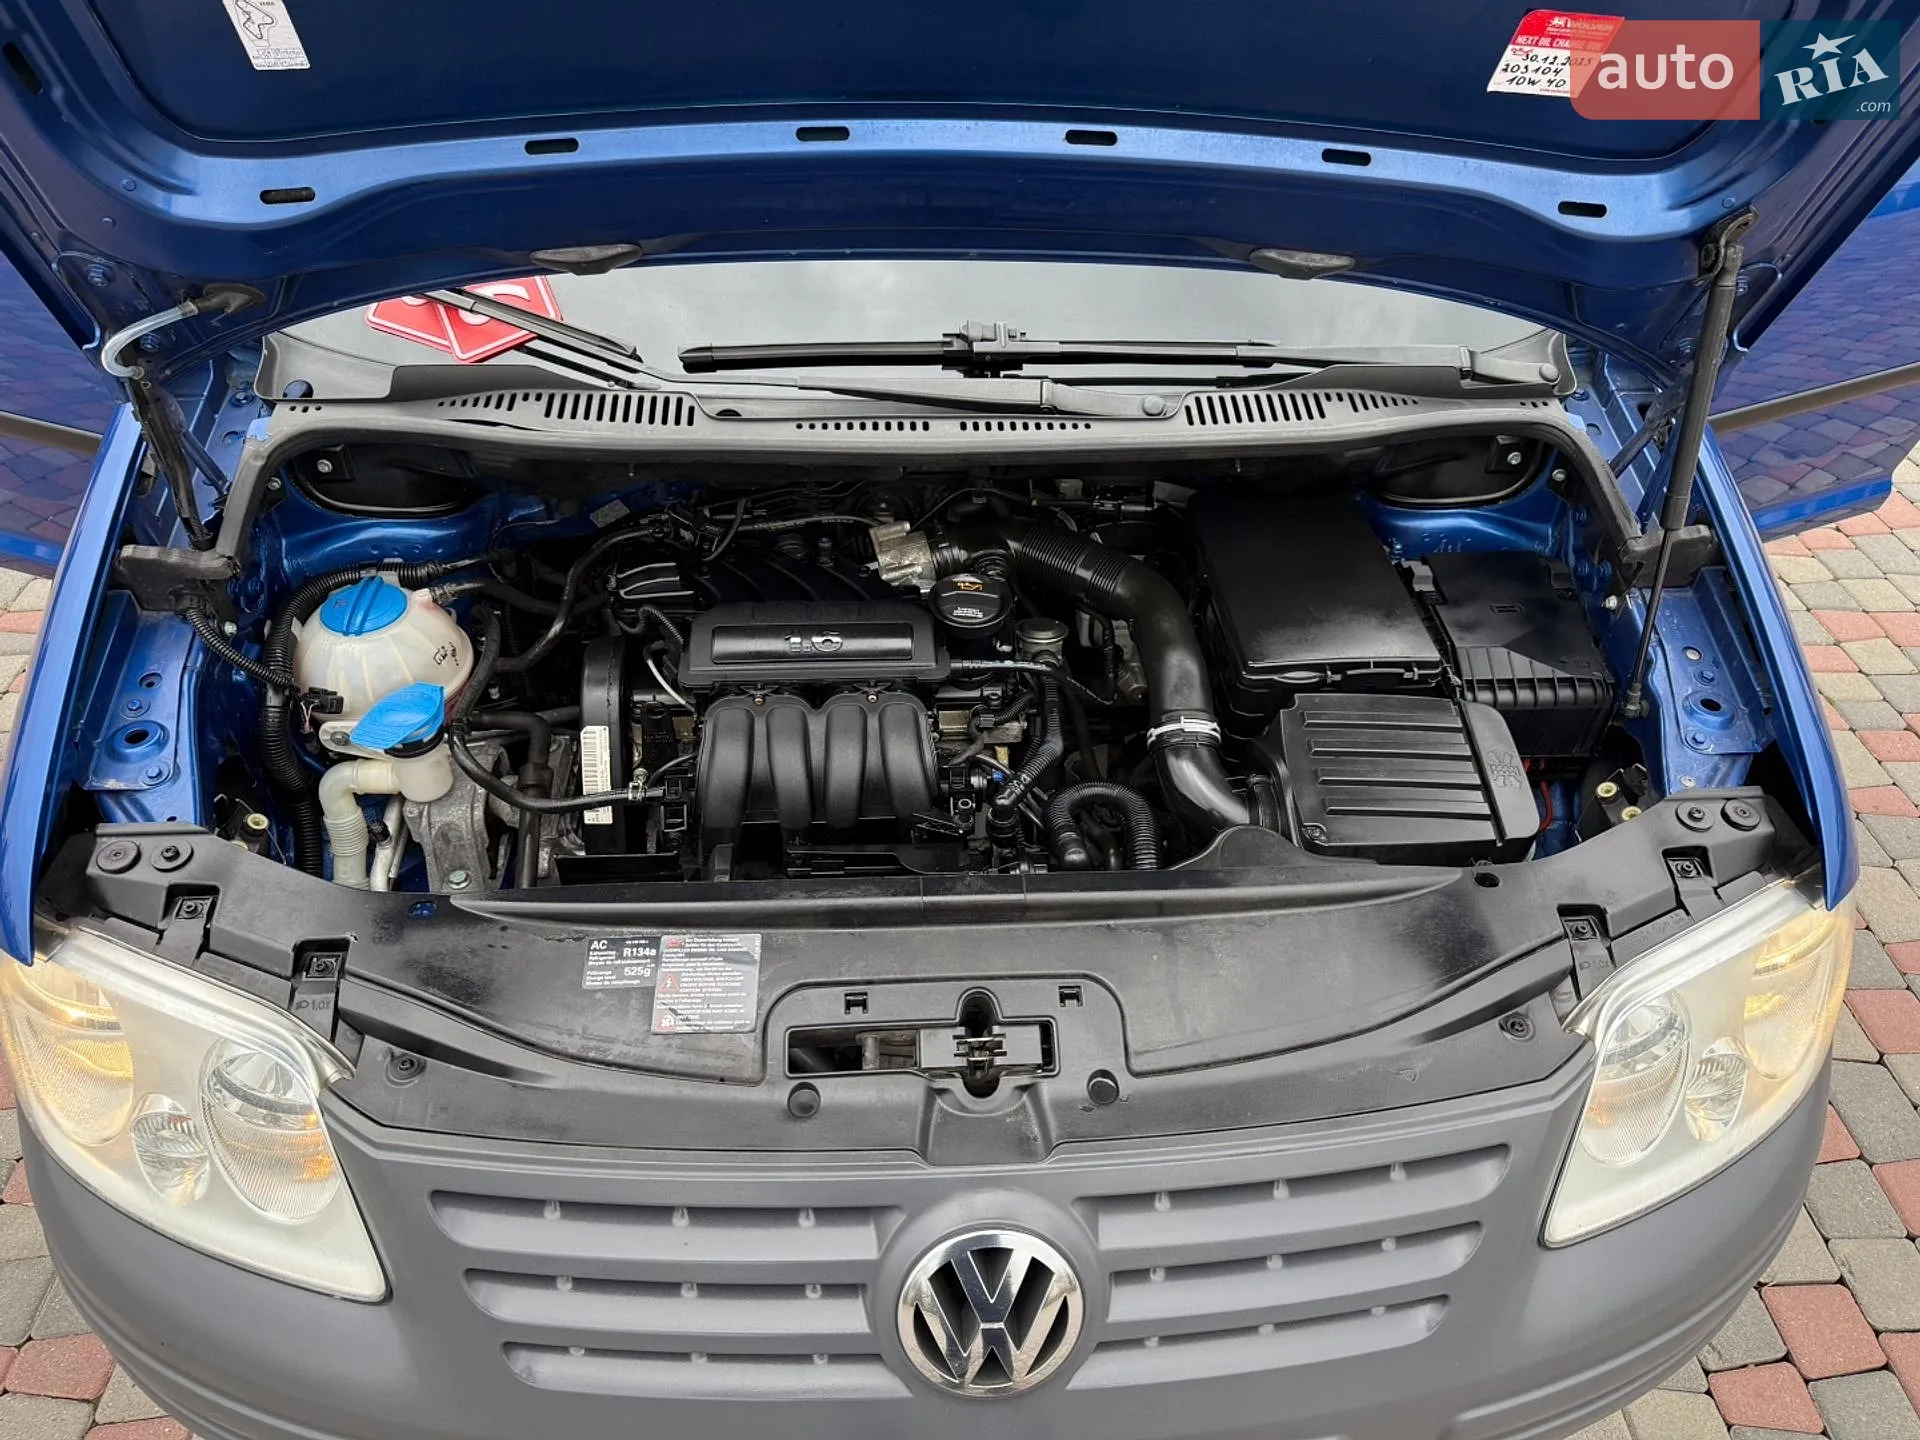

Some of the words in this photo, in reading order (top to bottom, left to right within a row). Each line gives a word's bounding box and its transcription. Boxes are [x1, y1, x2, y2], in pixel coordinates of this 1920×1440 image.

[1515, 35, 1536, 46] NEXT
[1538, 36, 1553, 47] OIL
[590, 940, 608, 950] AC
[623, 947, 657, 957] R134a
[624, 967, 651, 977] 525g
